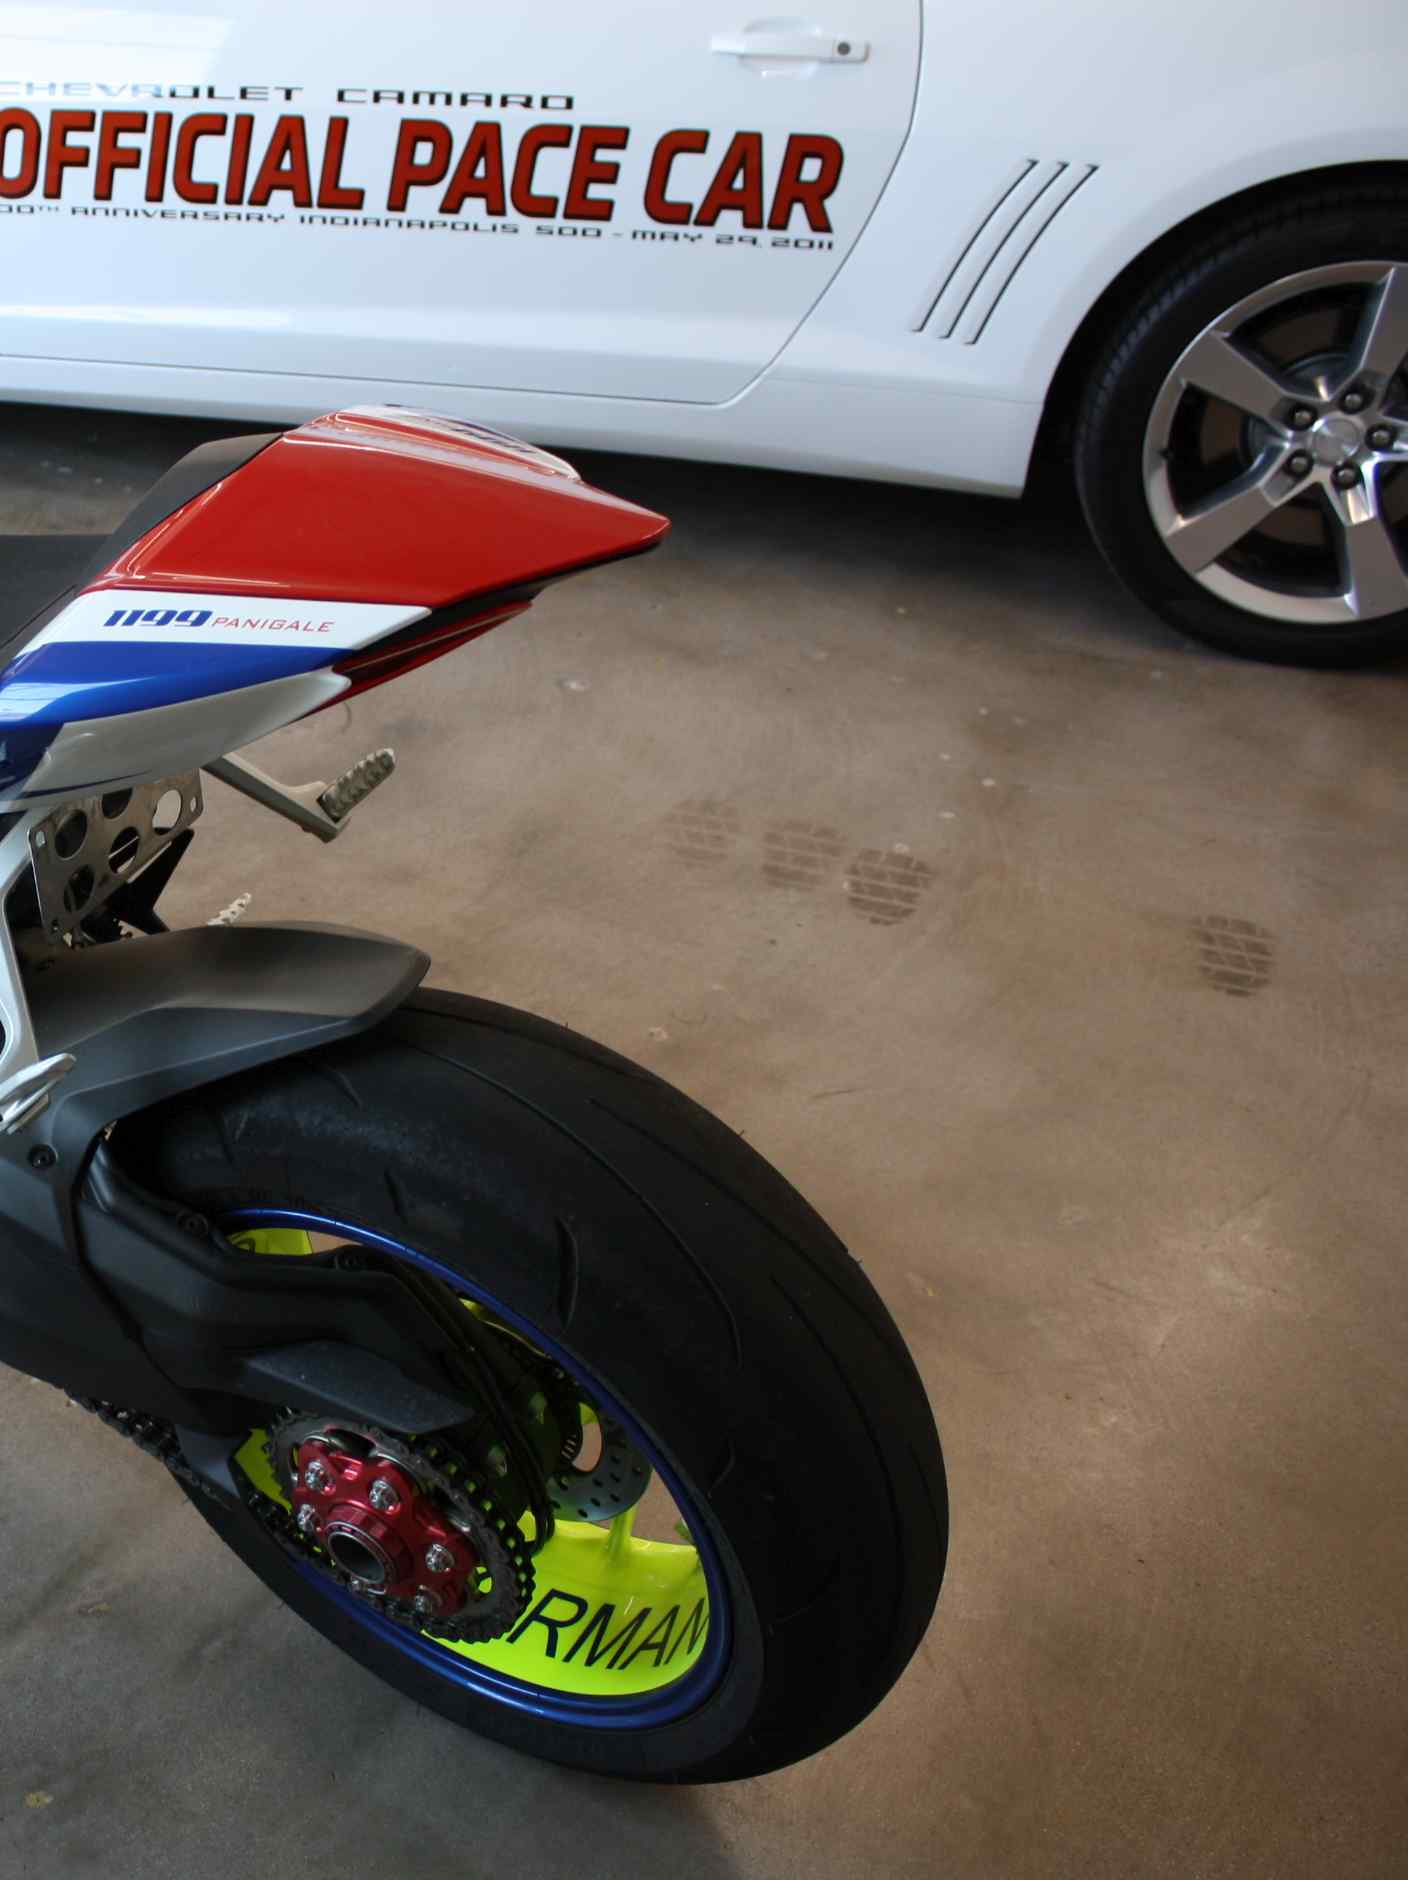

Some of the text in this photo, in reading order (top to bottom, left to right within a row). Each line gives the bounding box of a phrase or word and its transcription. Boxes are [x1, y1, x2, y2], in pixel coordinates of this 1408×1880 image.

[336, 89, 575, 110] CAMARO
[386, 118, 630, 222] PACE
[643, 129, 845, 234] CAR
[71, 206, 285, 224] ANNIVERSARY
[299, 215, 519, 234] INDIANAPOLIS
[535, 224, 602, 238] 500
[632, 229, 703, 243] MAY
[771, 237, 834, 250] 2011
[103, 609, 335, 633] 1199 PANIGALE
